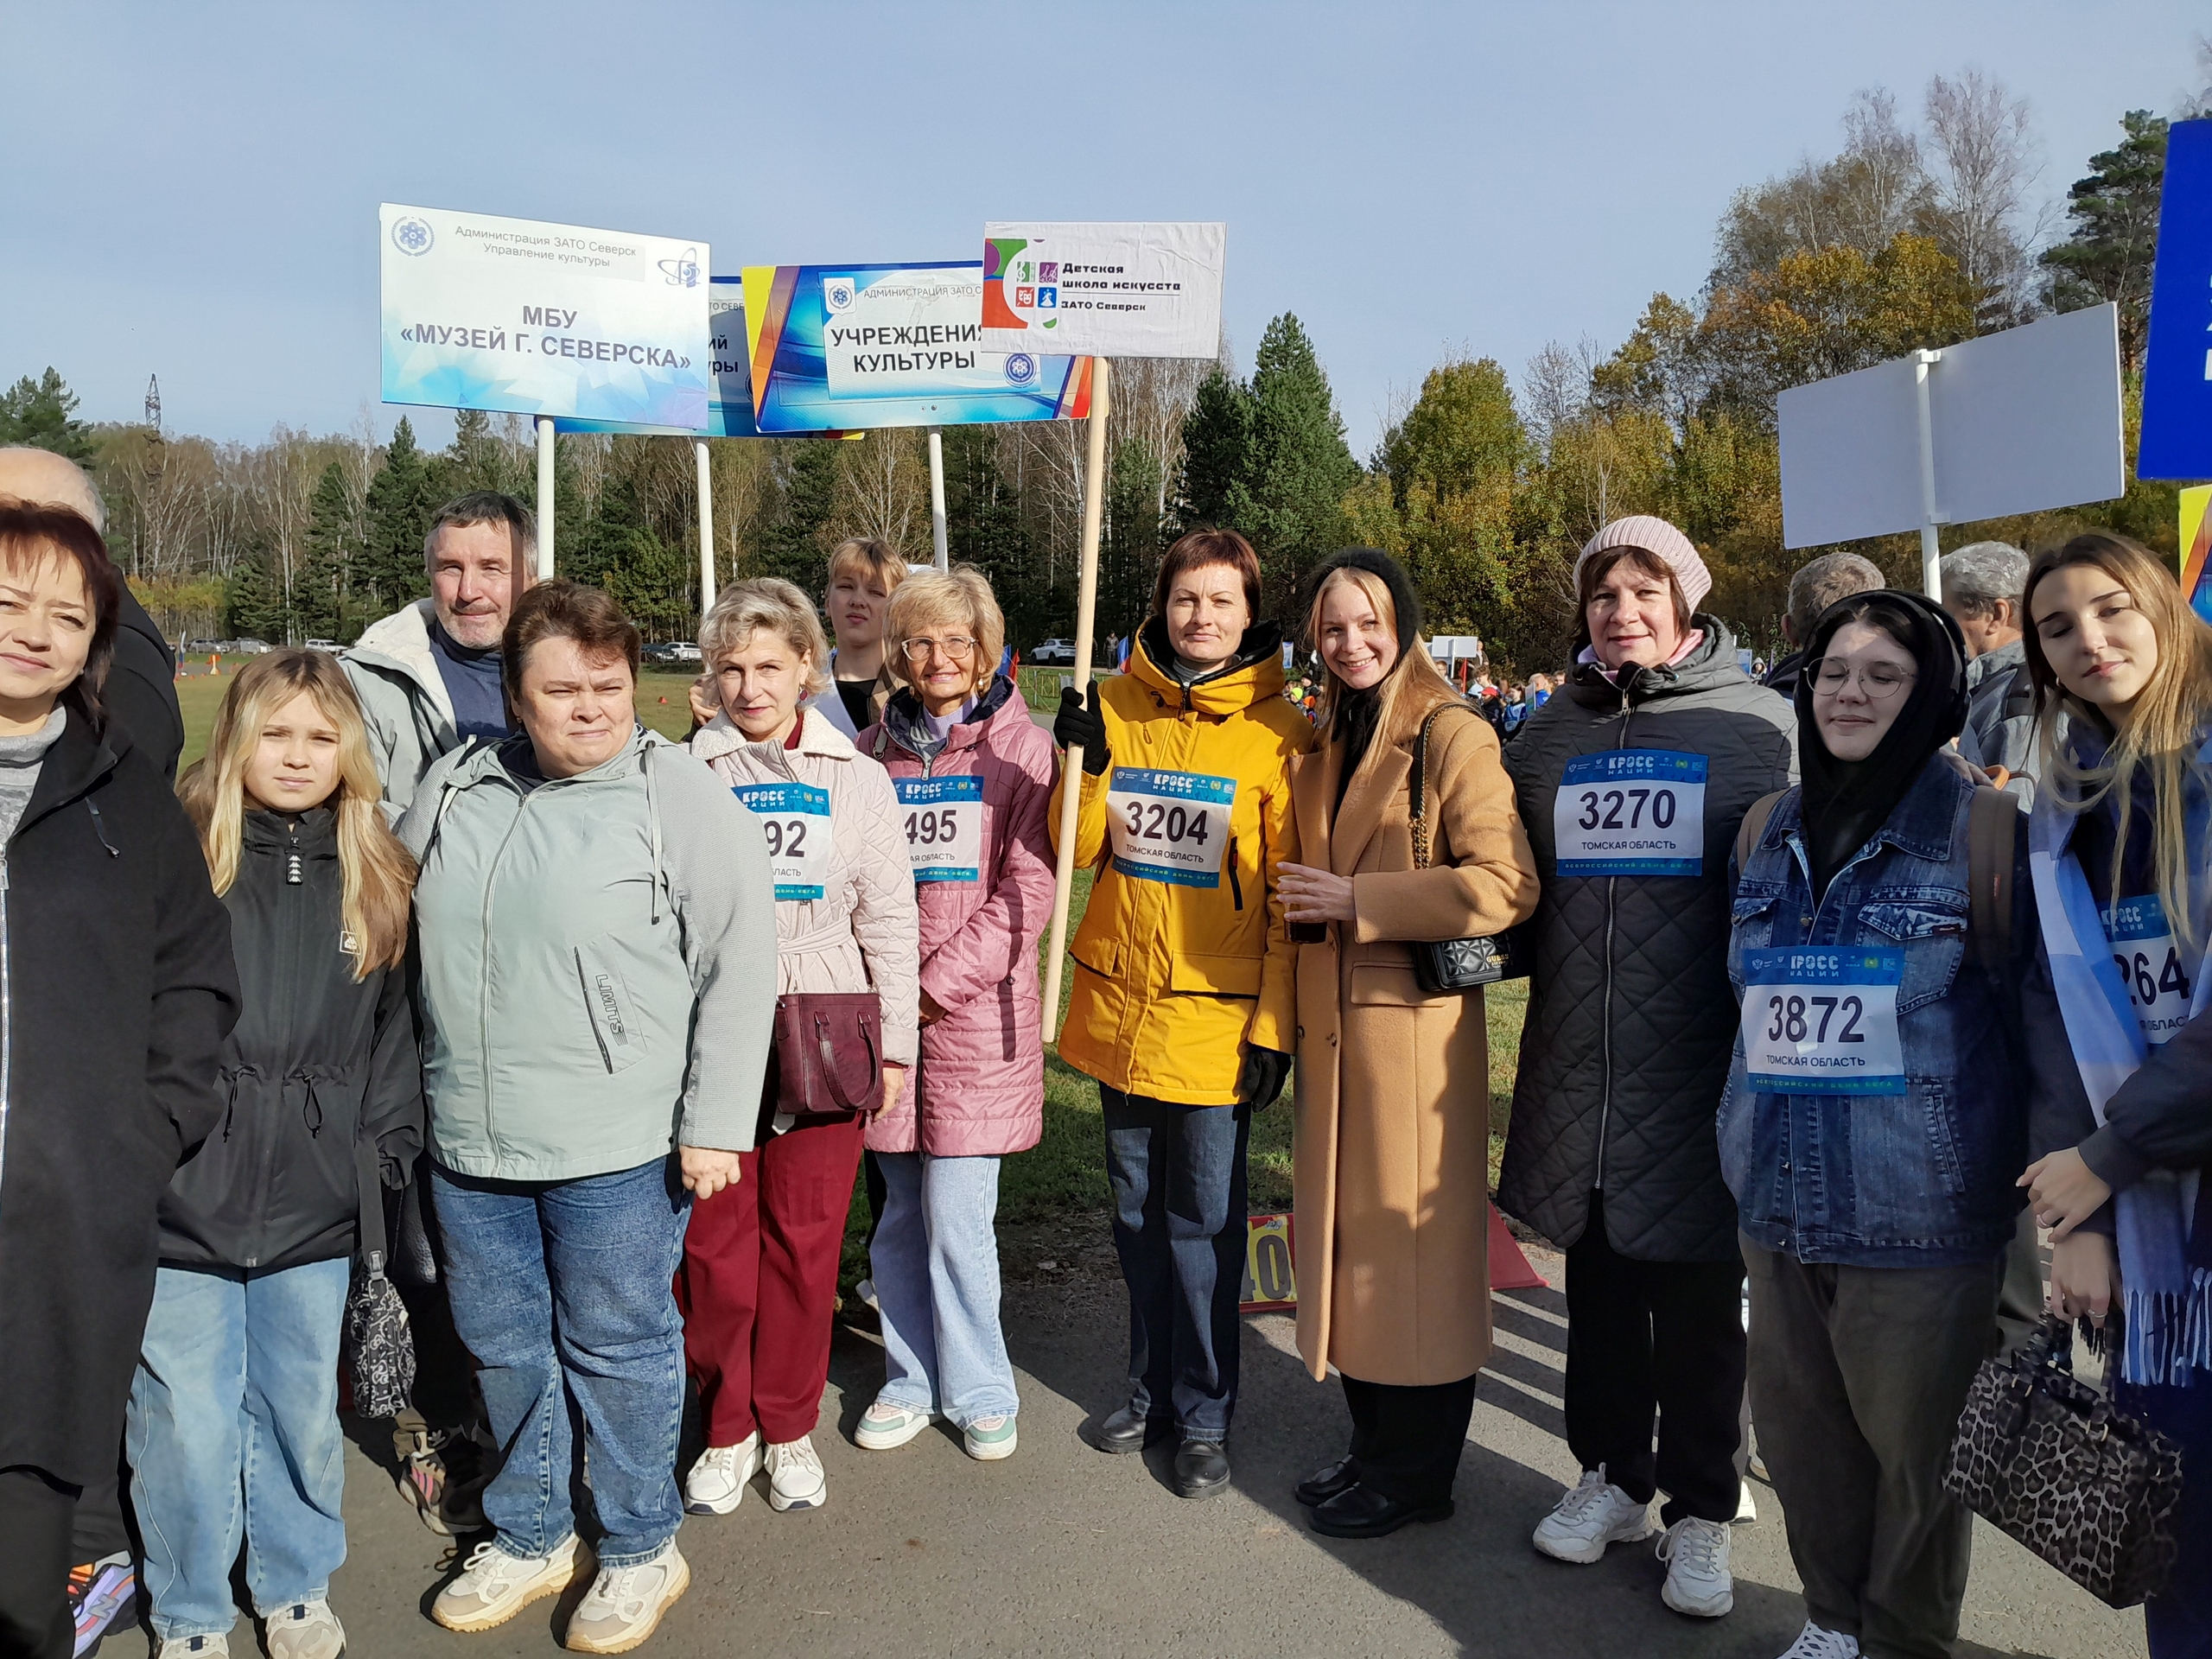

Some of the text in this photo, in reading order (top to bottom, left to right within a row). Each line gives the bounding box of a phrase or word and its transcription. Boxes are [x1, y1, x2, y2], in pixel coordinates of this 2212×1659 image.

[454, 226, 637, 257] Администрация ЗАТО Северск
[483, 243, 610, 268] Управление культуры
[1062, 263, 1124, 274] Детская
[863, 287, 949, 299] АДМИНИСТРАЦИЯ
[950, 286, 973, 296] ЗАТО
[1062, 279, 1108, 290] школа
[1061, 301, 1146, 312] ЗАТО Северск
[522, 305, 578, 329] МБУ
[400, 323, 692, 370] «МУЗЕЙ Г. СЕВЕРСКА»
[854, 351, 976, 373] КУЛЬТУРЫ
[1608, 755, 1655, 769] КРОСС
[1608, 767, 1654, 776] НАЦИИ
[906, 782, 942, 795] КРОСС
[1153, 784, 1192, 794] НАЦИИ
[1154, 773, 1194, 789] КРОСС
[742, 790, 785, 804] КРОСС
[1578, 789, 1676, 830] 3270
[904, 810, 957, 845] 495
[1126, 801, 1209, 846] 3204
[1126, 843, 1205, 863] ТОМСКАЯ ОБЛАСТЬ
[1581, 840, 1676, 850] ТОМСКАЯ ОБЛАСТЬ
[921, 853, 956, 862] ОБЛАСТЬ
[595, 974, 624, 1035] LIMITS
[1768, 995, 1865, 1043] 3872
[2146, 1014, 2189, 1032] ОБЛАС
[1766, 1054, 1866, 1067] ТОМСКАЯ ОБЛАСТЬ
